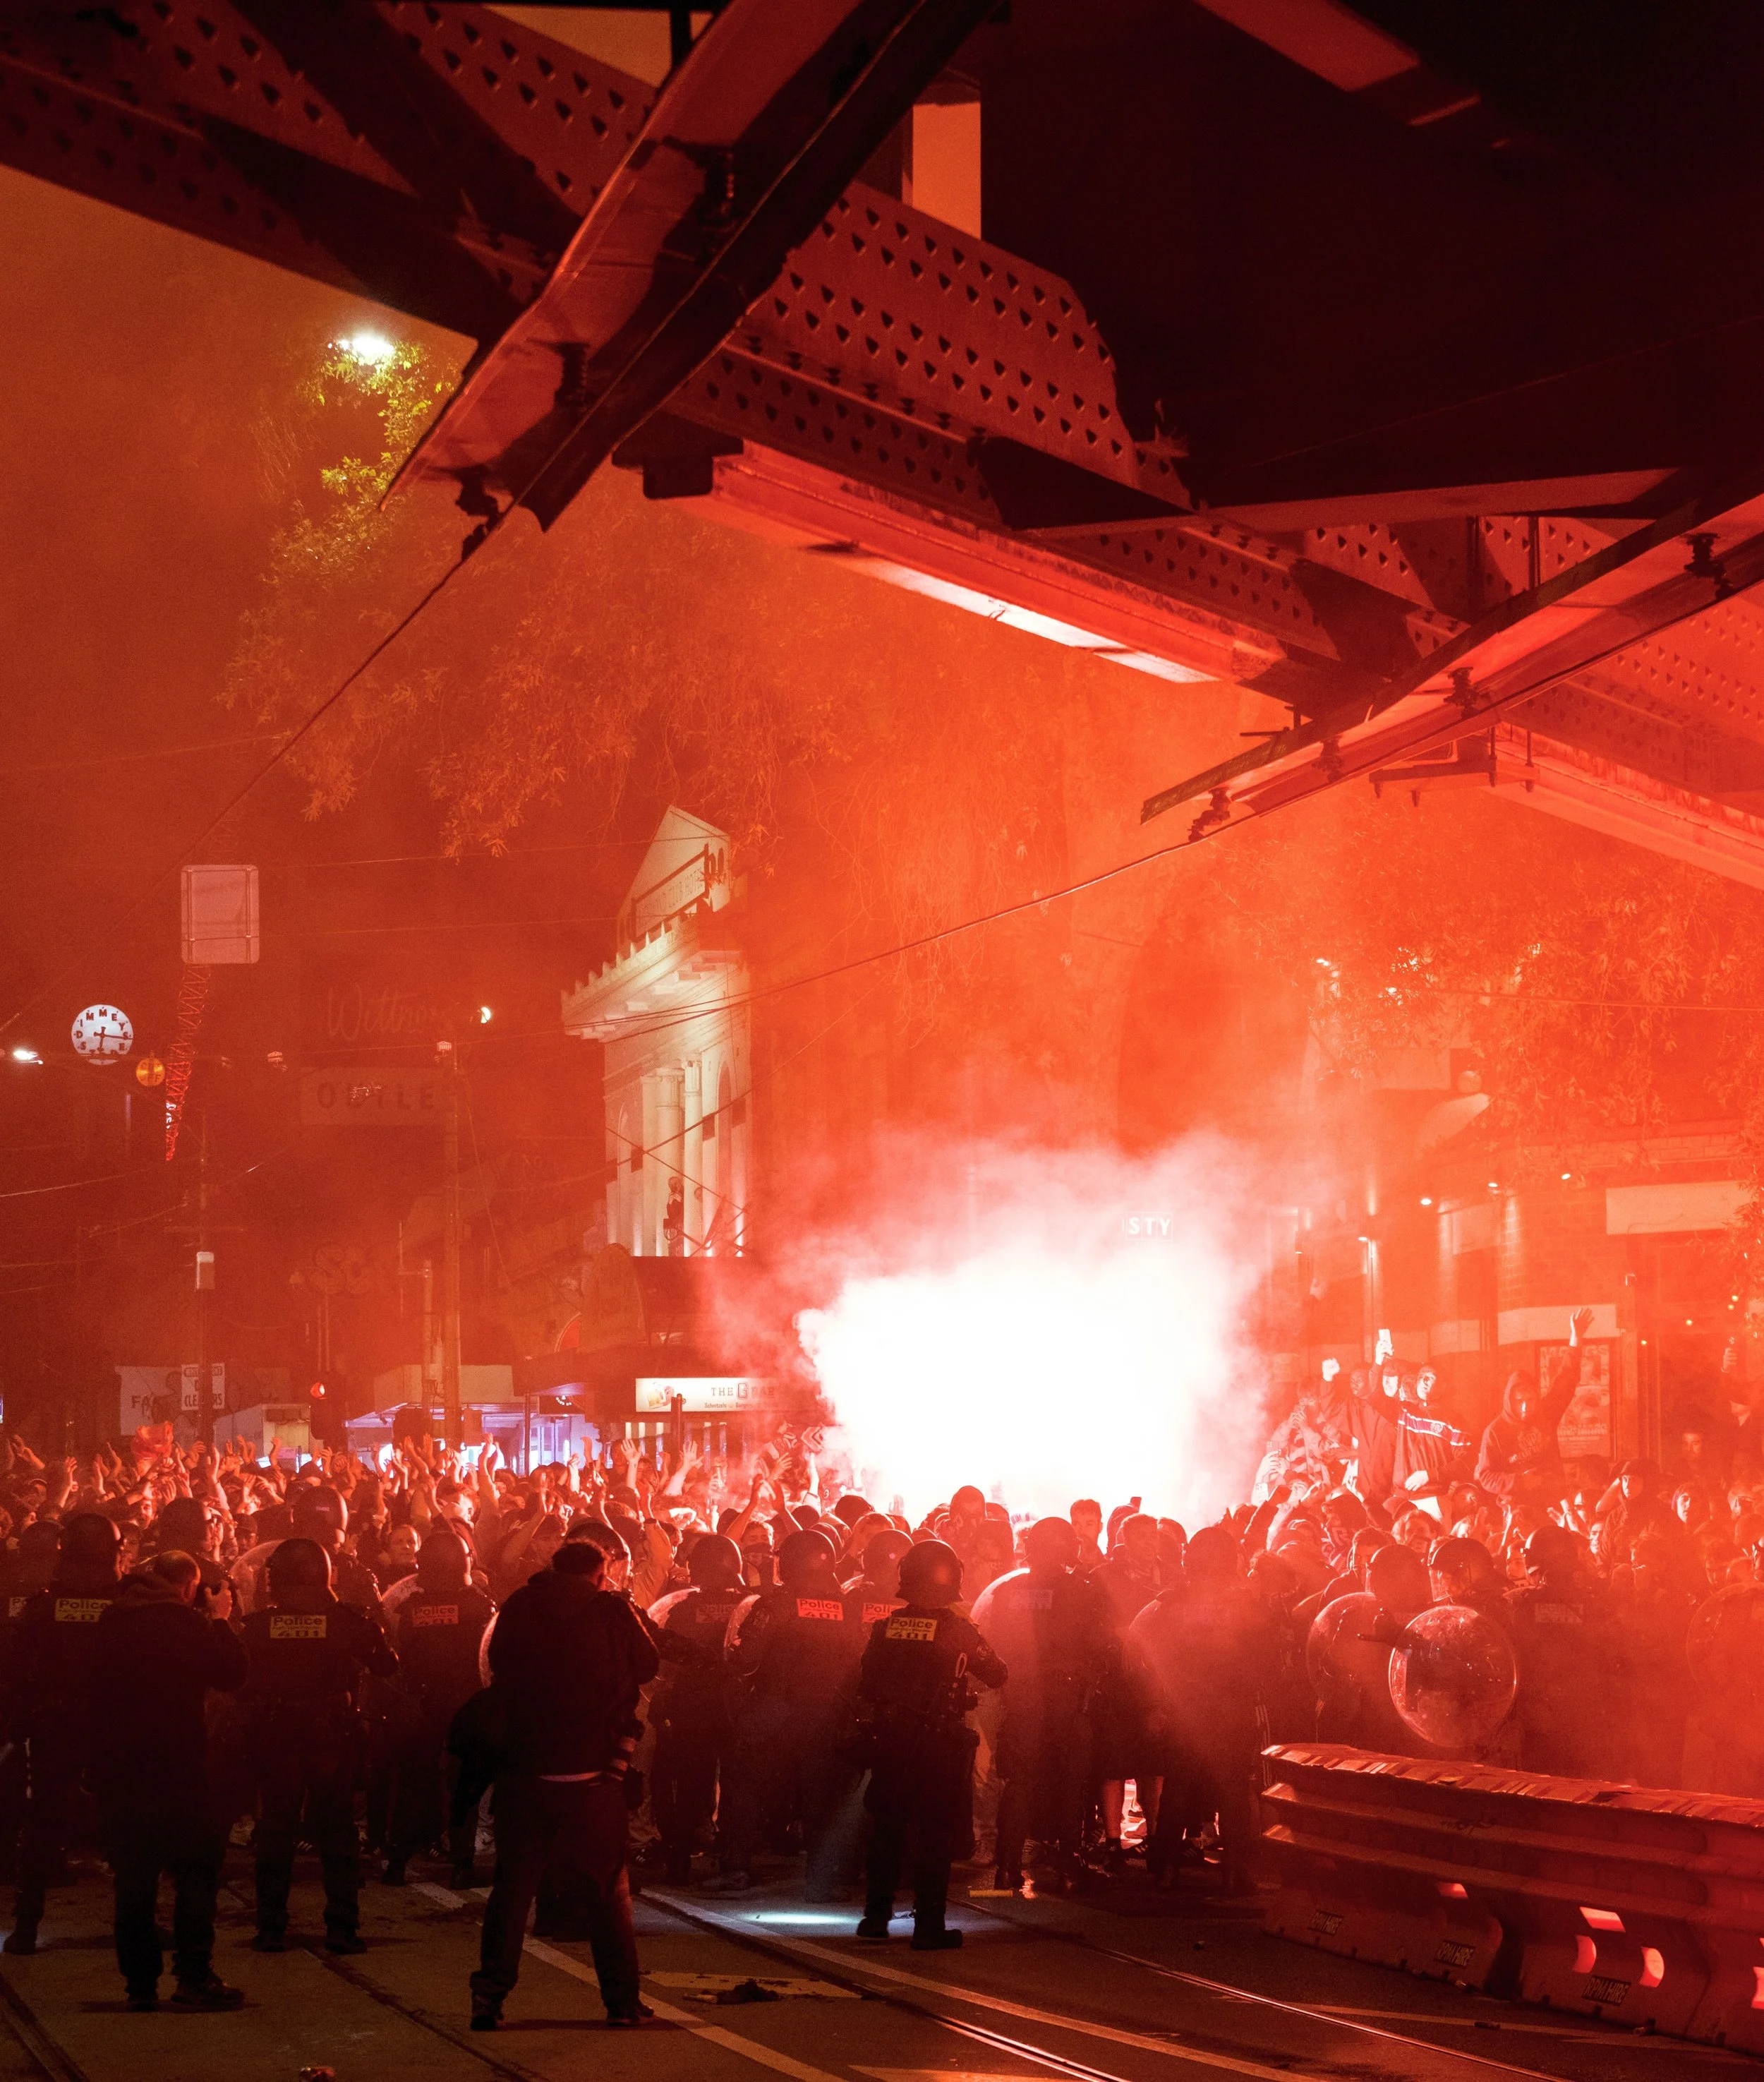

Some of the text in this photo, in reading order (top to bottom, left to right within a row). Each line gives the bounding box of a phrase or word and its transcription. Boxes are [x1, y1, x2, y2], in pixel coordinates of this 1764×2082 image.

[711, 1387, 734, 1397] THE
[737, 1381, 749, 1400] G
[59, 1599, 107, 1610] Police
[799, 1599, 840, 1611] Police
[865, 1603, 890, 1613] Poli
[415, 1606, 455, 1615] Police
[274, 1616, 322, 1626] Police
[890, 1618, 934, 1630] Police
[1583, 1977, 1629, 2004] RPM HIRE
